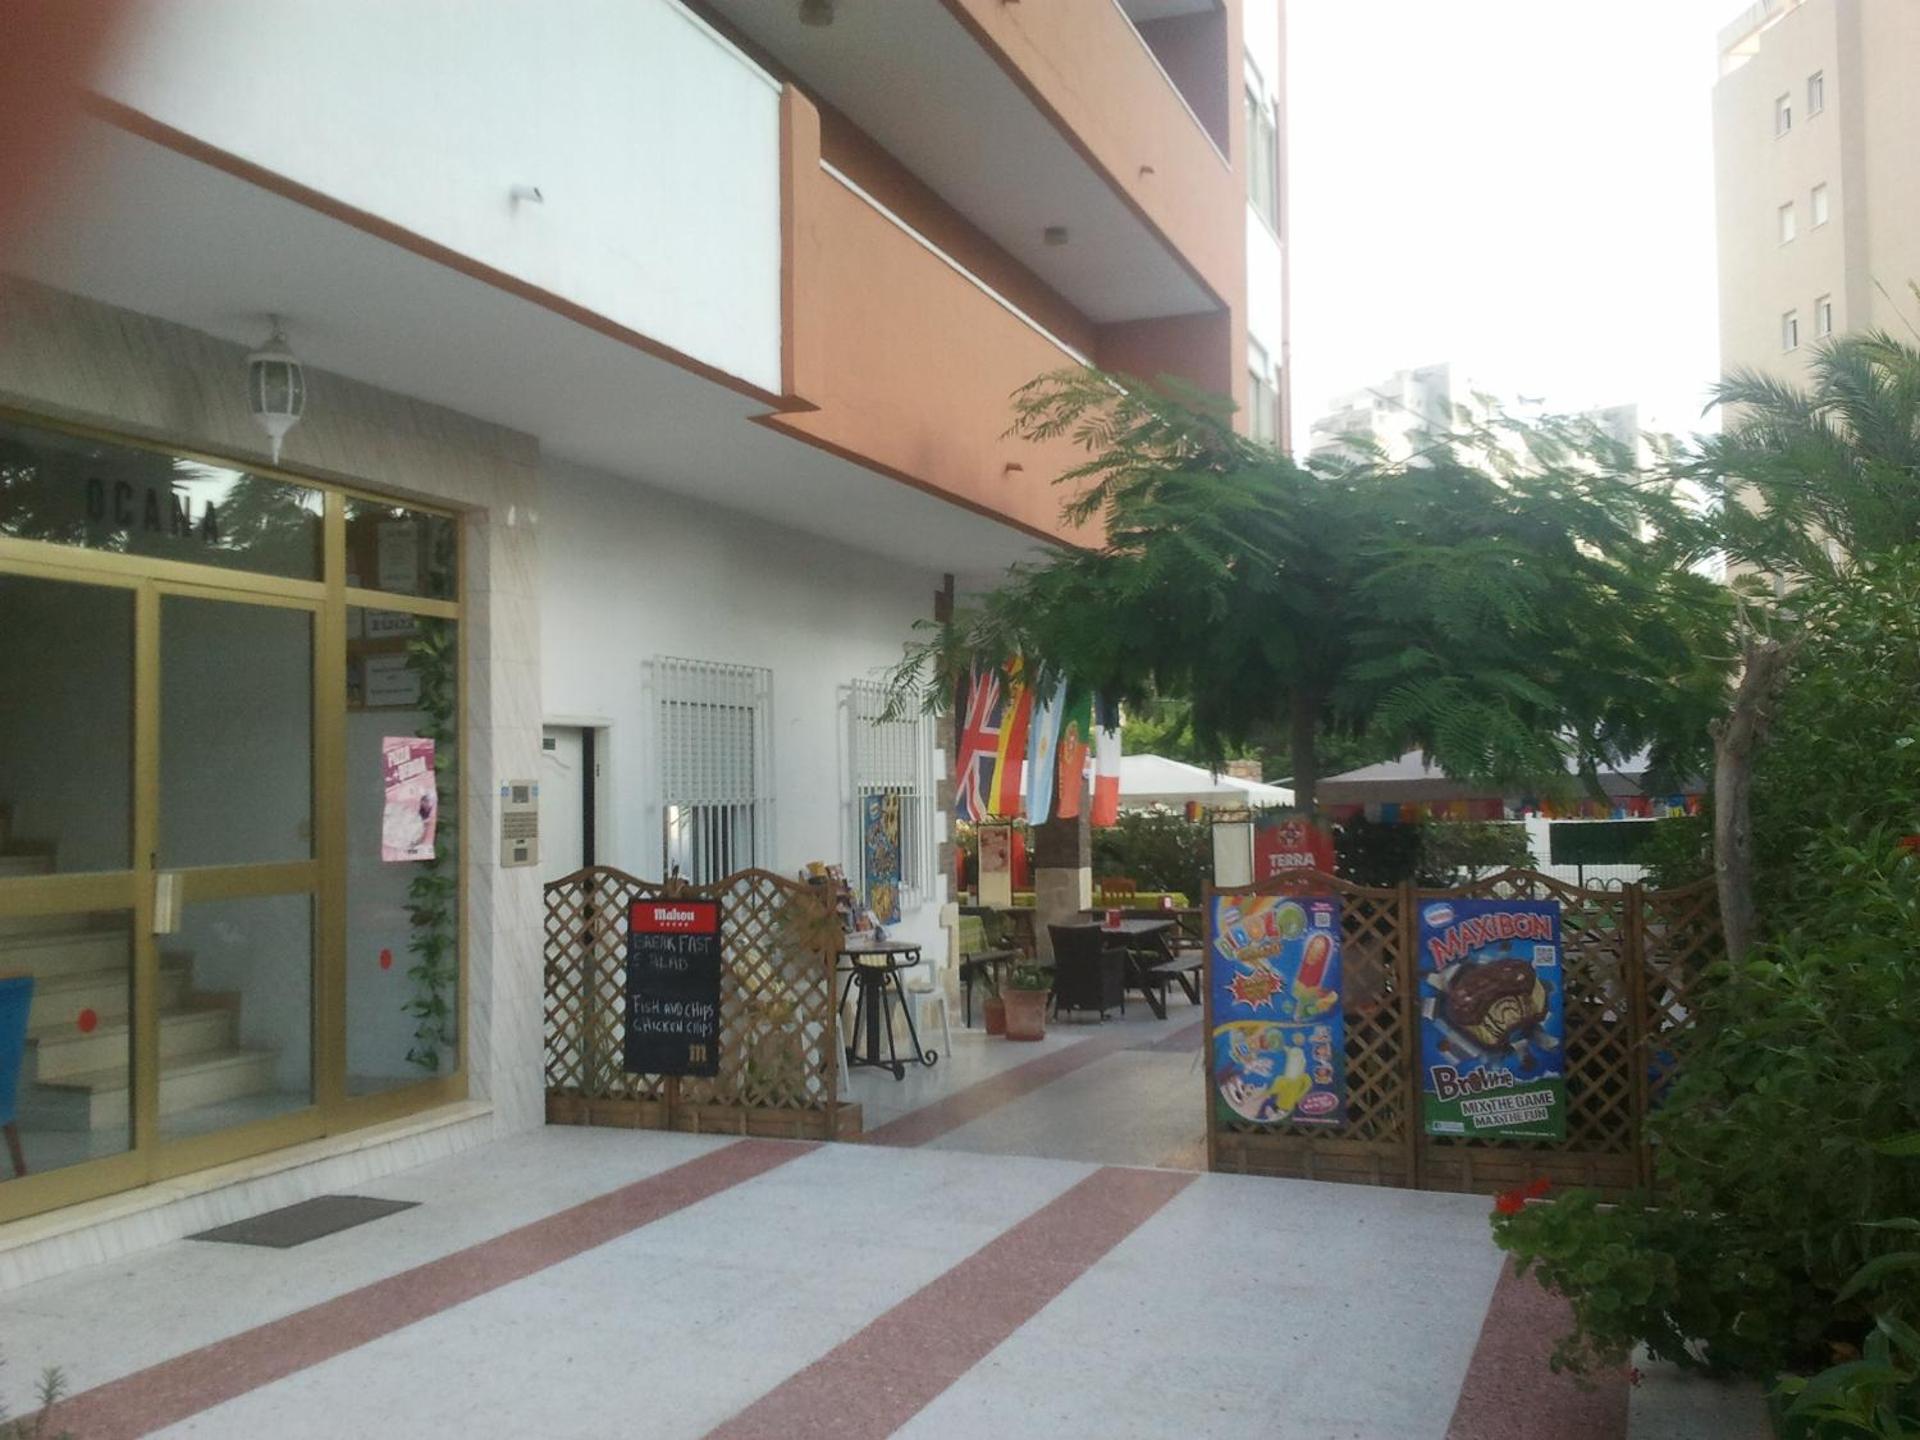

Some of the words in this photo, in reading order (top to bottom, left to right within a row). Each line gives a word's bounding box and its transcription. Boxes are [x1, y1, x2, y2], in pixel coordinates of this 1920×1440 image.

[1268, 852, 1316, 867] TERRA
[654, 908, 695, 921] Mahou
[1428, 912, 1552, 969] MAXIBON
[1516, 1092, 1553, 1107] GAME
